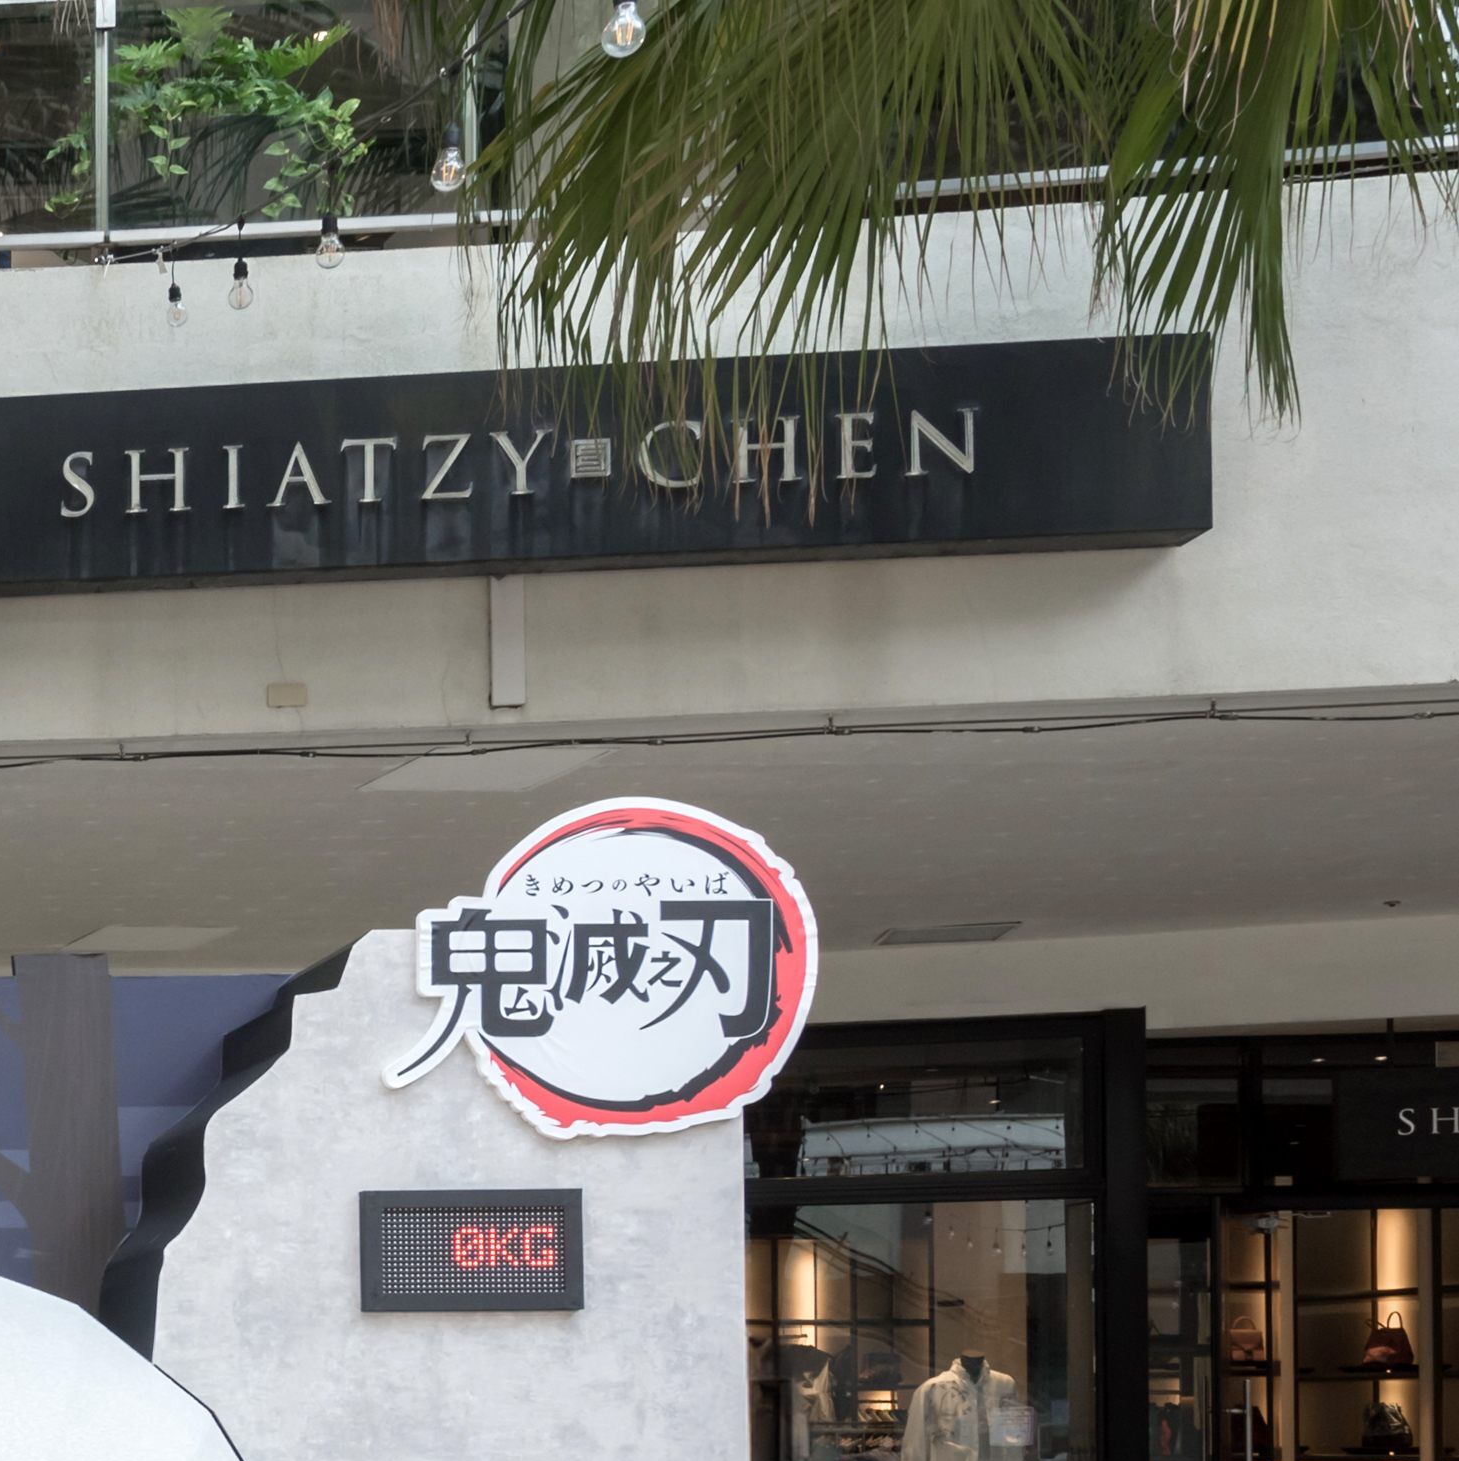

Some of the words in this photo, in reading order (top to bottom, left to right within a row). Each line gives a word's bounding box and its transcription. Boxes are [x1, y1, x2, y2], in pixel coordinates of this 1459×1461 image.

[60, 428, 553, 517] SHIATZY
[639, 407, 979, 488] CHEN
[525, 872, 729, 896] きめつのやいば
[398, 899, 773, 1076] 鬼滅之刃
[1397, 1106, 1459, 1136] SH
[453, 1227, 554, 1267] 0KG
